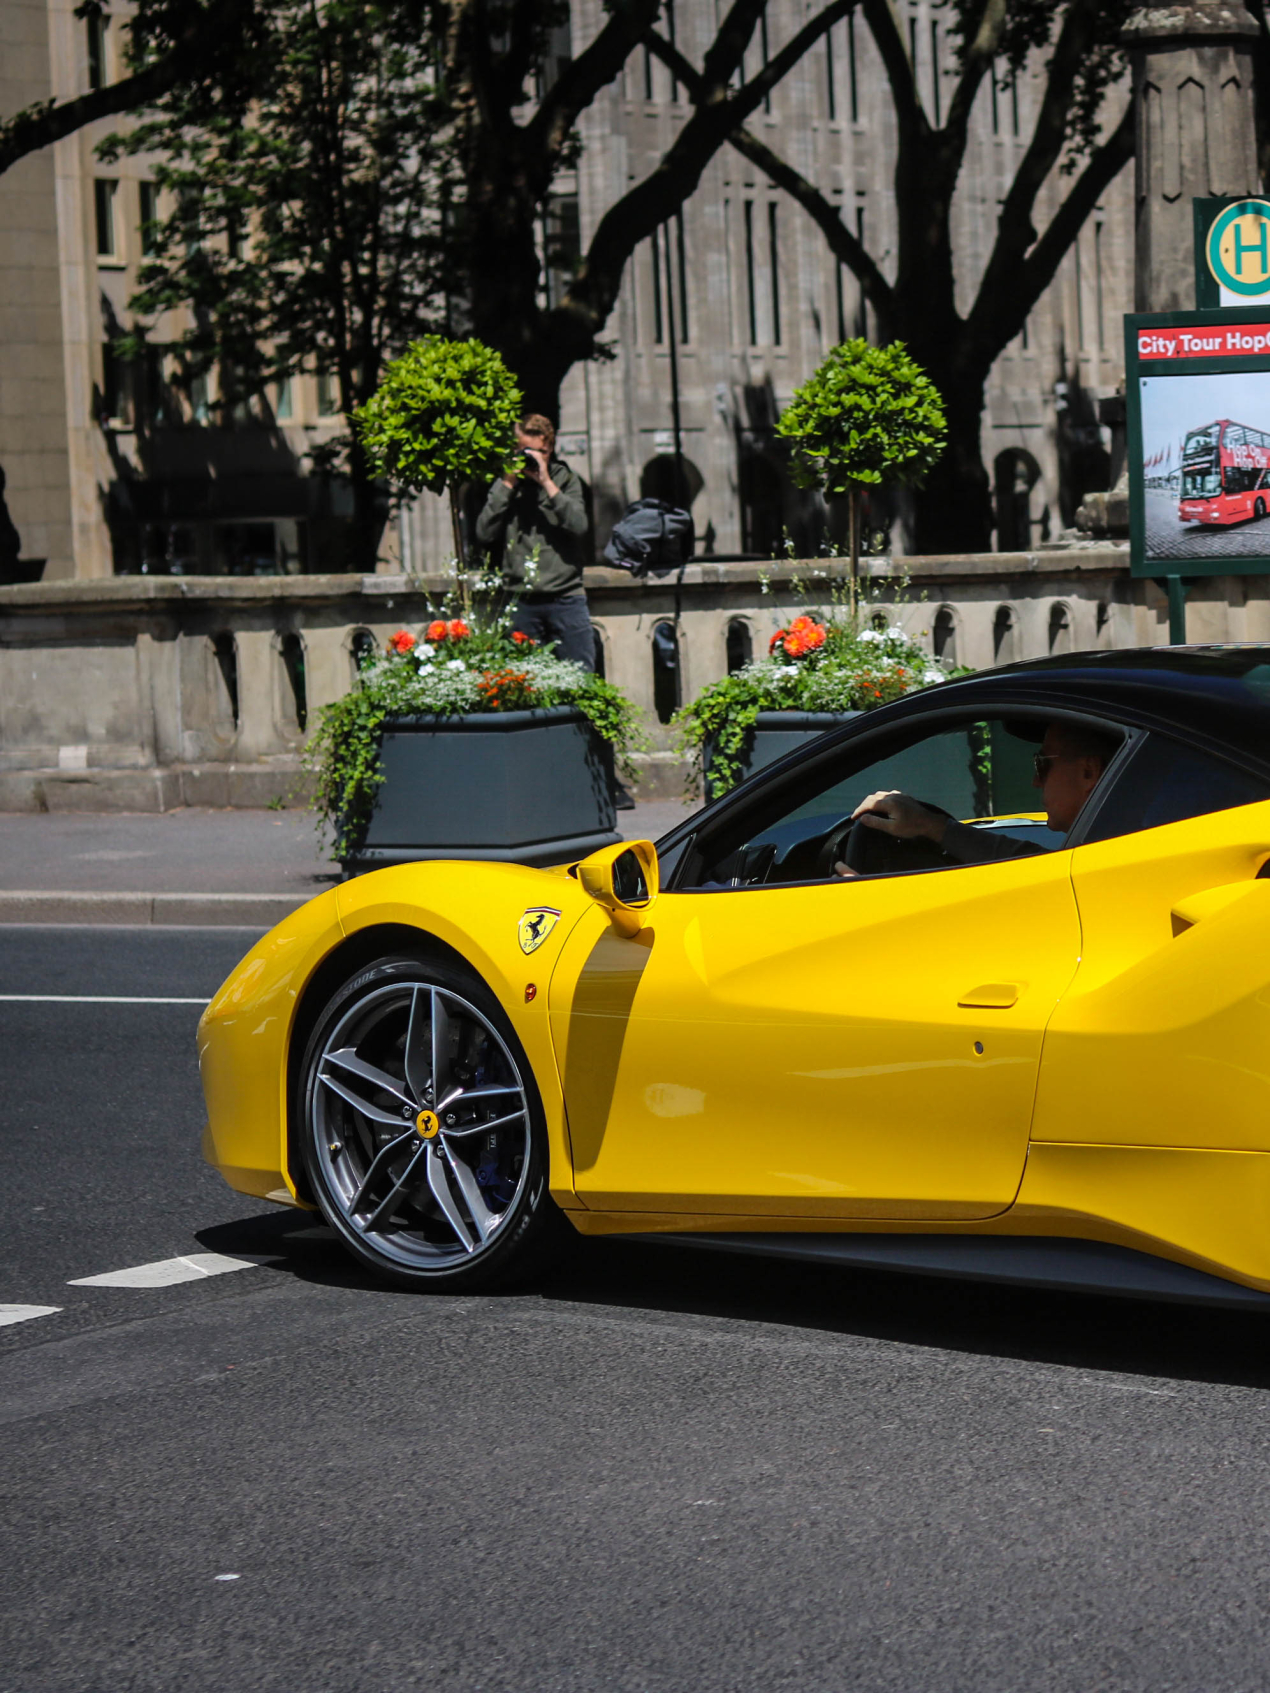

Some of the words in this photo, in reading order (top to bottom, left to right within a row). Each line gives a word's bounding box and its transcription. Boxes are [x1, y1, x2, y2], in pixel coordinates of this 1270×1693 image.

[1234, 222, 1268, 275] H
[1138, 336, 1176, 356] City
[1179, 334, 1222, 352] Tour
